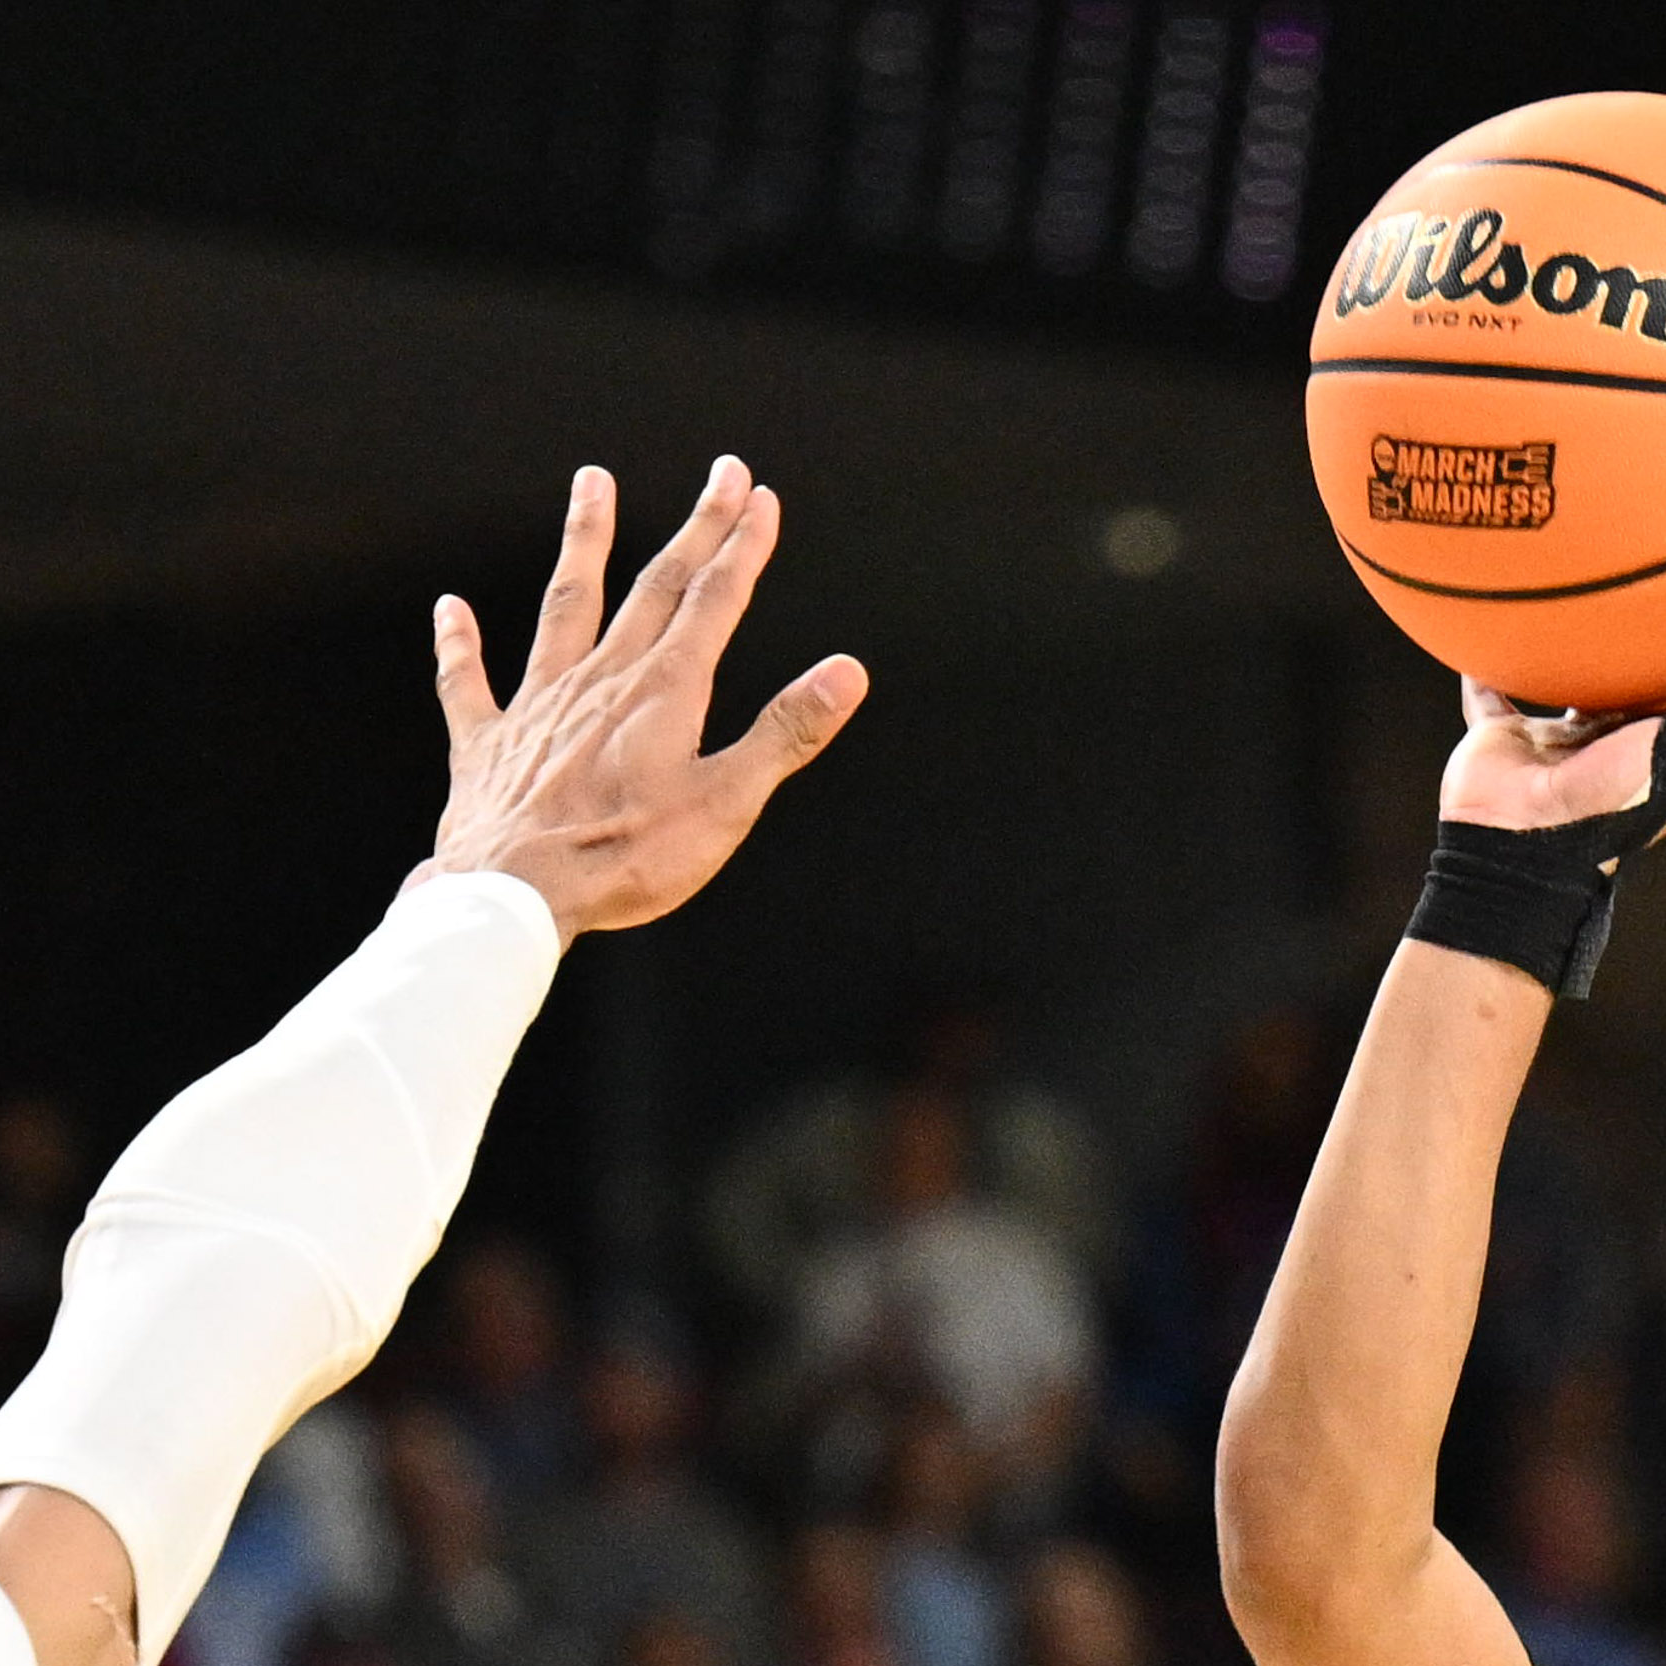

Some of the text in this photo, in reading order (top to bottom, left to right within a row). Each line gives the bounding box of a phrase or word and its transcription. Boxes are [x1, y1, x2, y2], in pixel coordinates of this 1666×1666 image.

[1412, 310, 1523, 330] EVO NXT
[1396, 442, 1497, 485] MARCH
[1409, 480, 1551, 521] MADNESS
